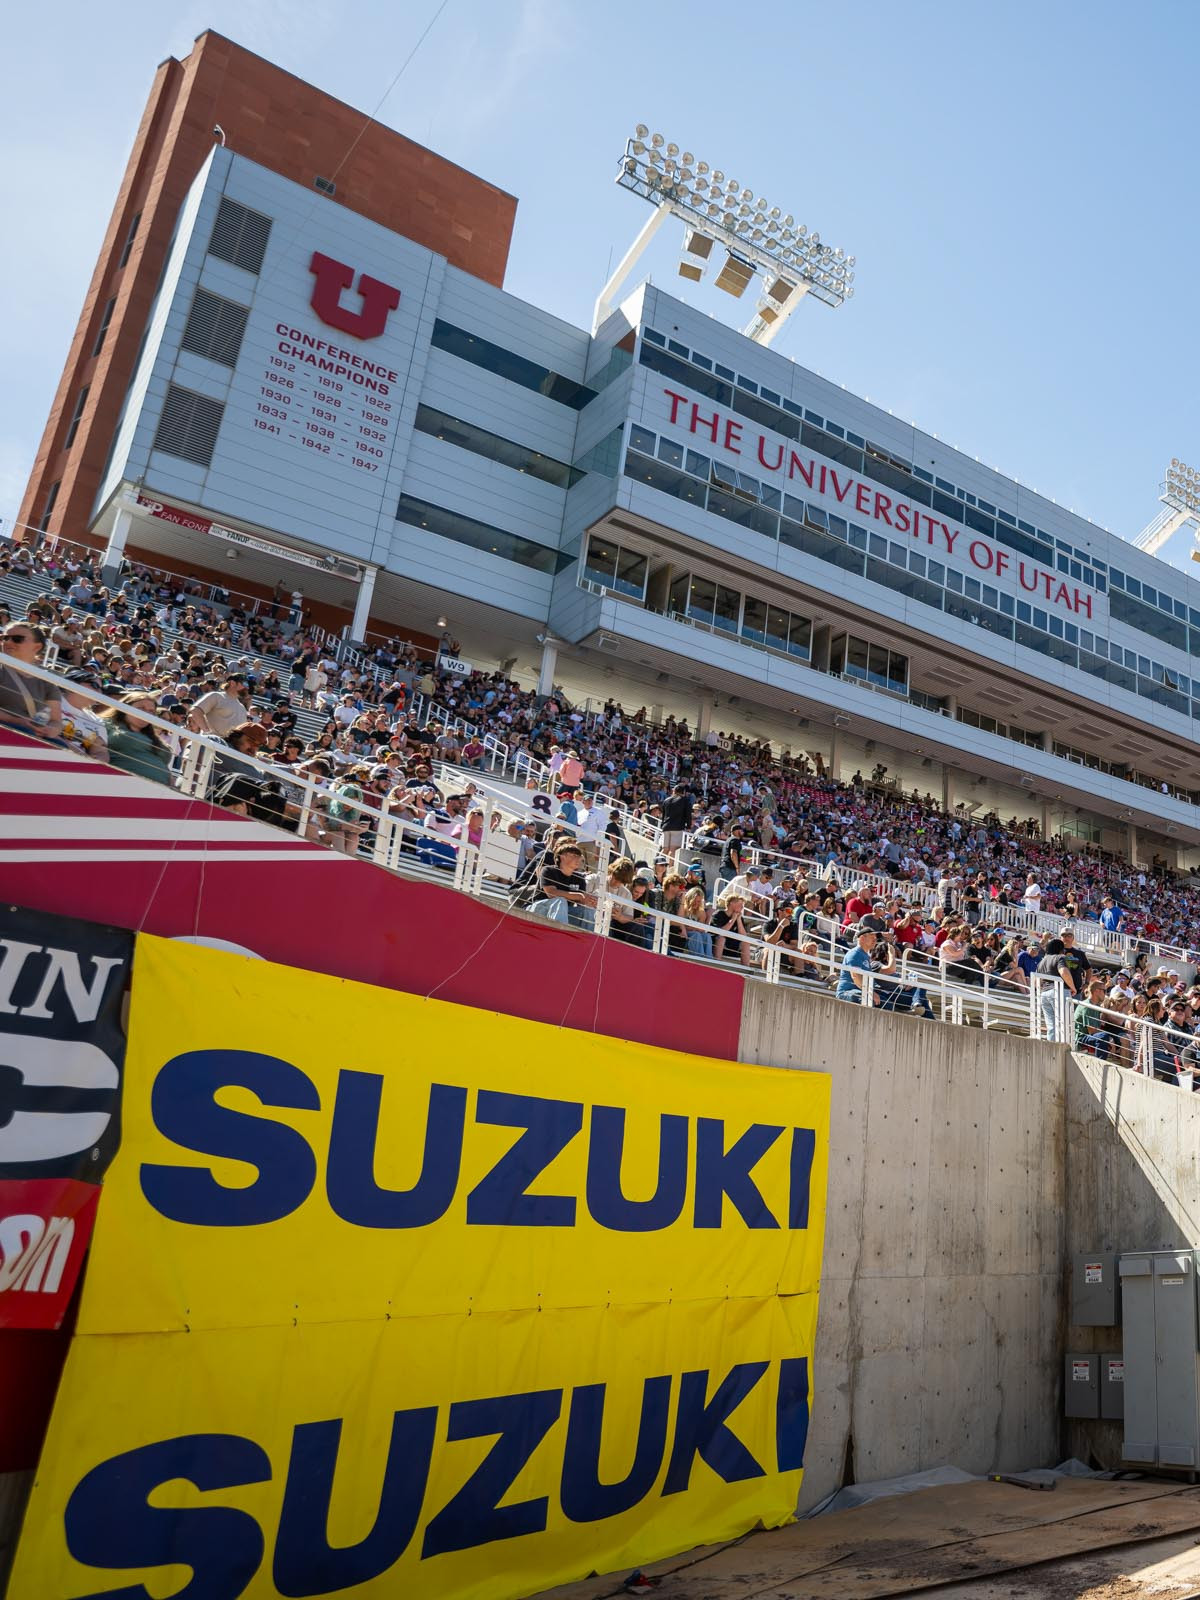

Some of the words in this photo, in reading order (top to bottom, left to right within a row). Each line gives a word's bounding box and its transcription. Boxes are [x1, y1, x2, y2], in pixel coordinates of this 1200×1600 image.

[275, 323, 399, 384] CONFERENCE
[277, 341, 390, 396] CHAMPIONS
[264, 370, 294, 390] 1926
[312, 390, 342, 408] 1928
[361, 410, 389, 427] 1929
[269, 355, 296, 373] 1912
[318, 375, 344, 392] 1919
[364, 394, 392, 412] 1922
[256, 402, 288, 421] 1933
[306, 422, 336, 440] 1938
[356, 441, 384, 458] 1940
[260, 386, 292, 405] 1930
[311, 406, 337, 423] 1931
[359, 426, 387, 442] 1932
[253, 418, 281, 436] 1941
[301, 436, 332, 454] 1942
[352, 456, 379, 472] 1947
[160, 511, 180, 524] FAN
[182, 519, 208, 533] FONE
[663, 388, 744, 455] THE
[757, 435, 960, 555] UNIVERSITY
[969, 540, 1011, 577] OF
[1018, 562, 1093, 619] UTAH
[448, 660, 465, 672] W9
[139, 1048, 816, 1232] SUZUKI
[64, 1356, 811, 1600] SUZUKI
